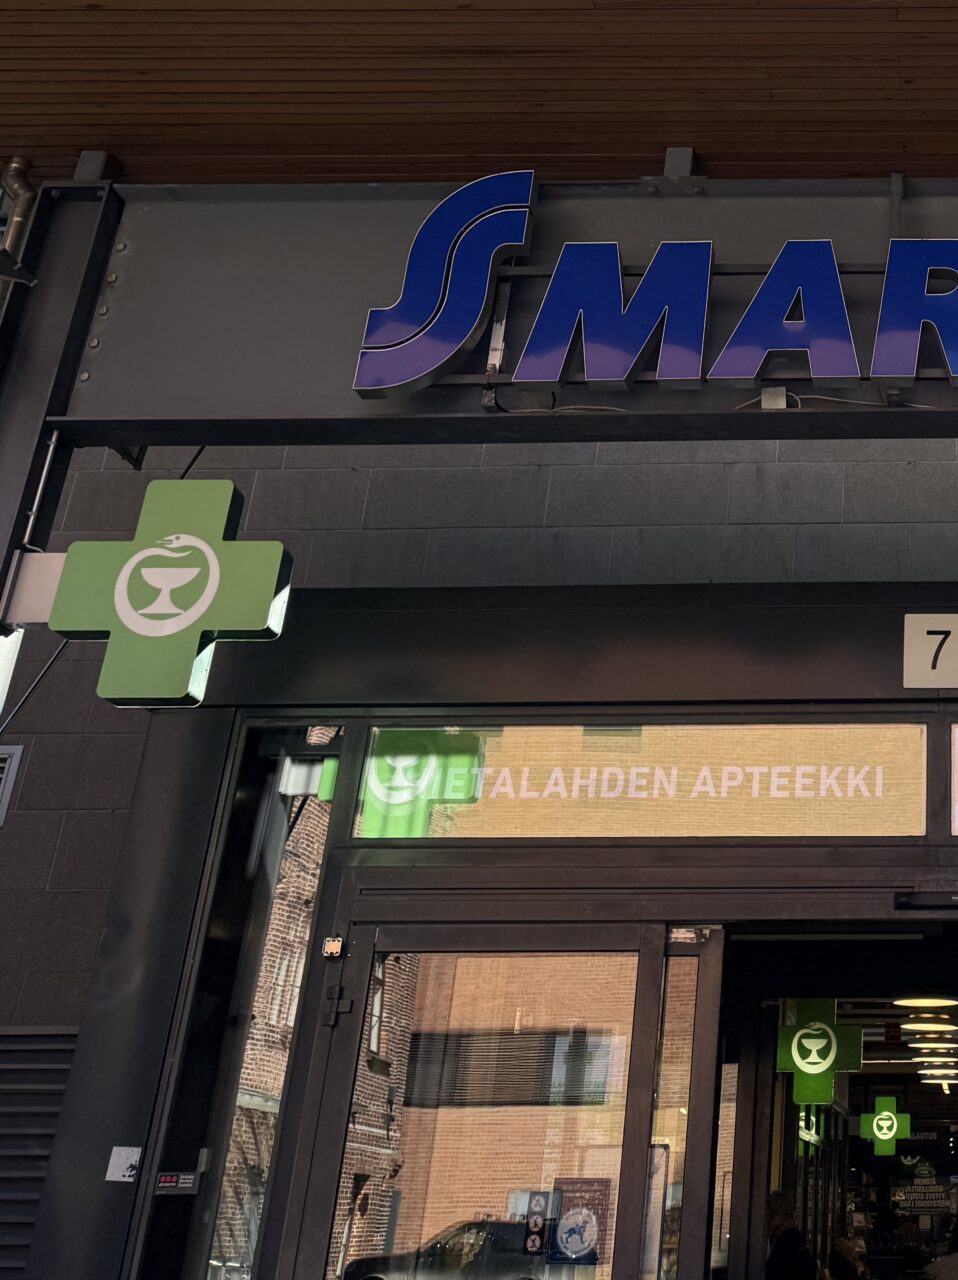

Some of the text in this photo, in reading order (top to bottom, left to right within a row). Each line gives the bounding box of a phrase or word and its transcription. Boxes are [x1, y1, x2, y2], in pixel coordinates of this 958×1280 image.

[353, 169, 534, 392] S
[926, 629, 952, 671] 7
[690, 764, 884, 799] APTEEKKI
